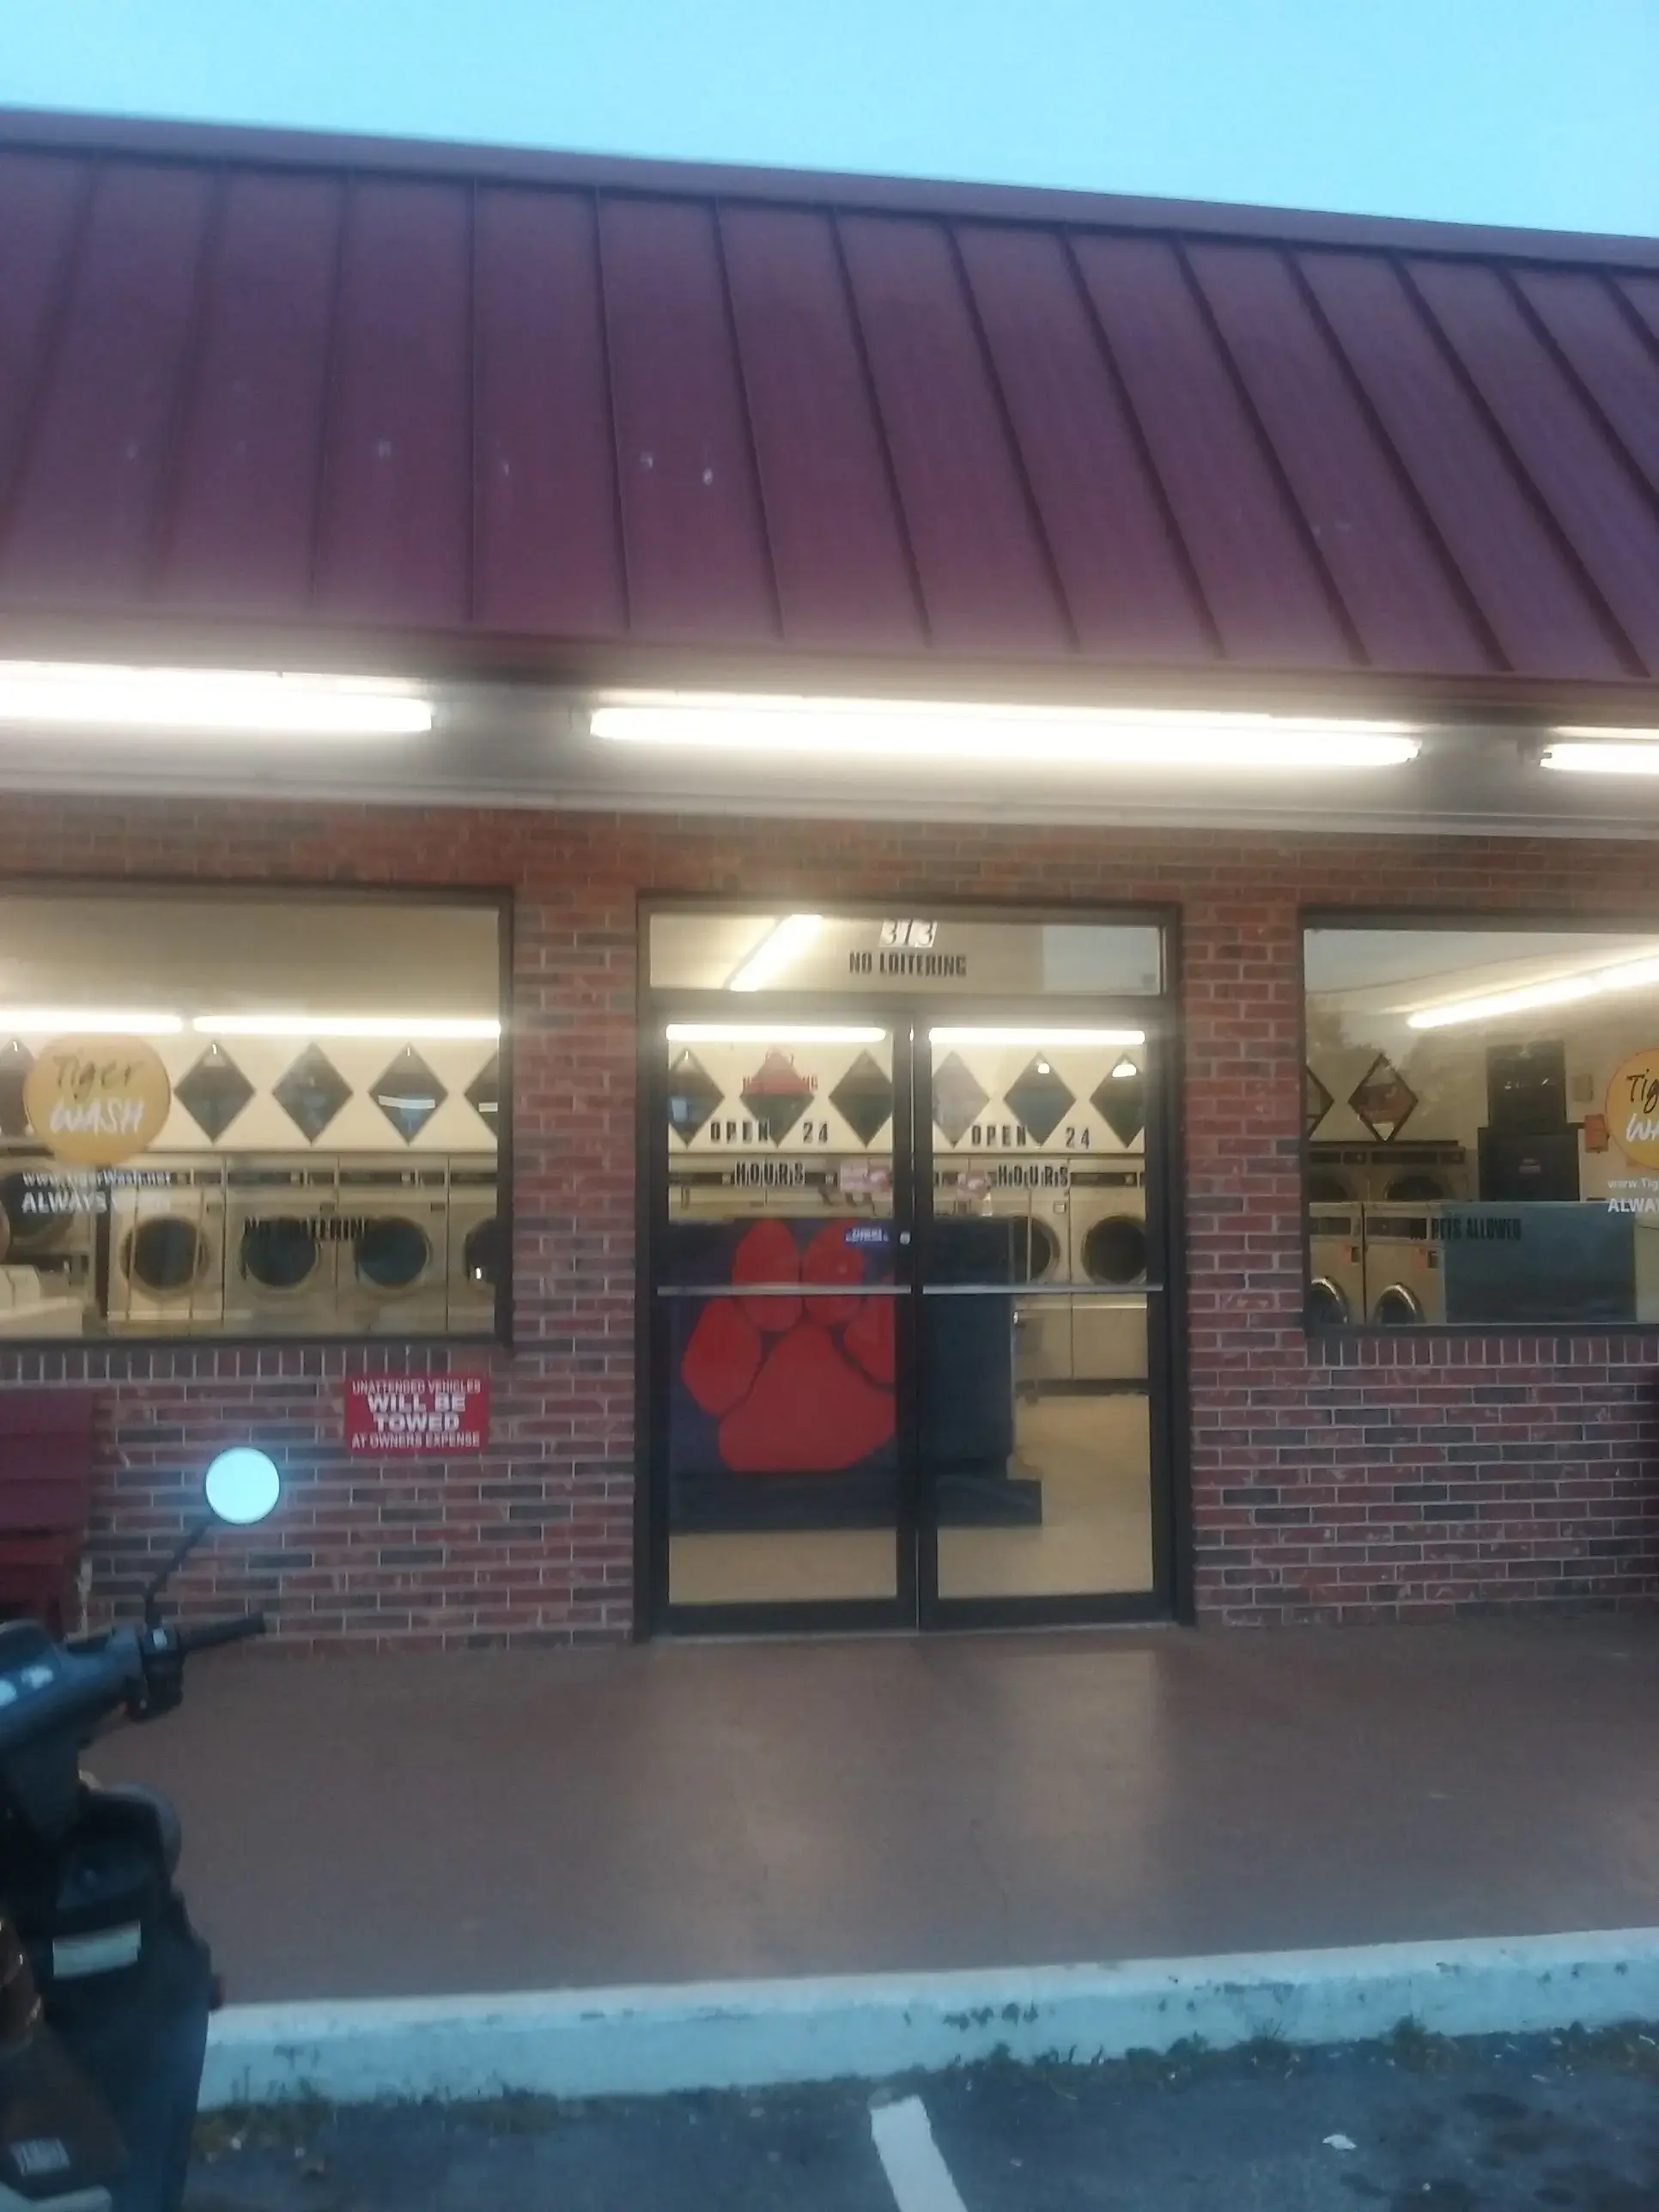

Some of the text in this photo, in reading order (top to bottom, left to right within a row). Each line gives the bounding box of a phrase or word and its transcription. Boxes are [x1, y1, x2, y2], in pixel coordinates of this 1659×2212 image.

[849, 951, 967, 977] NO LOITERING
[49, 1096, 144, 1137] WASH
[710, 1118, 829, 1144] OPEN 24
[971, 1123, 1091, 1149] OPEN 24
[735, 1160, 805, 1187] HOURS
[997, 1164, 1070, 1188] HOURS
[1431, 1217, 1462, 1240] PETS
[352, 1378, 481, 1395] UNATTENDED VEHICLES
[368, 1391, 466, 1413] WILL BE
[373, 1413, 460, 1433] TOWED
[351, 1432, 368, 1449] AT
[425, 1431, 480, 1448] EXPENSE
